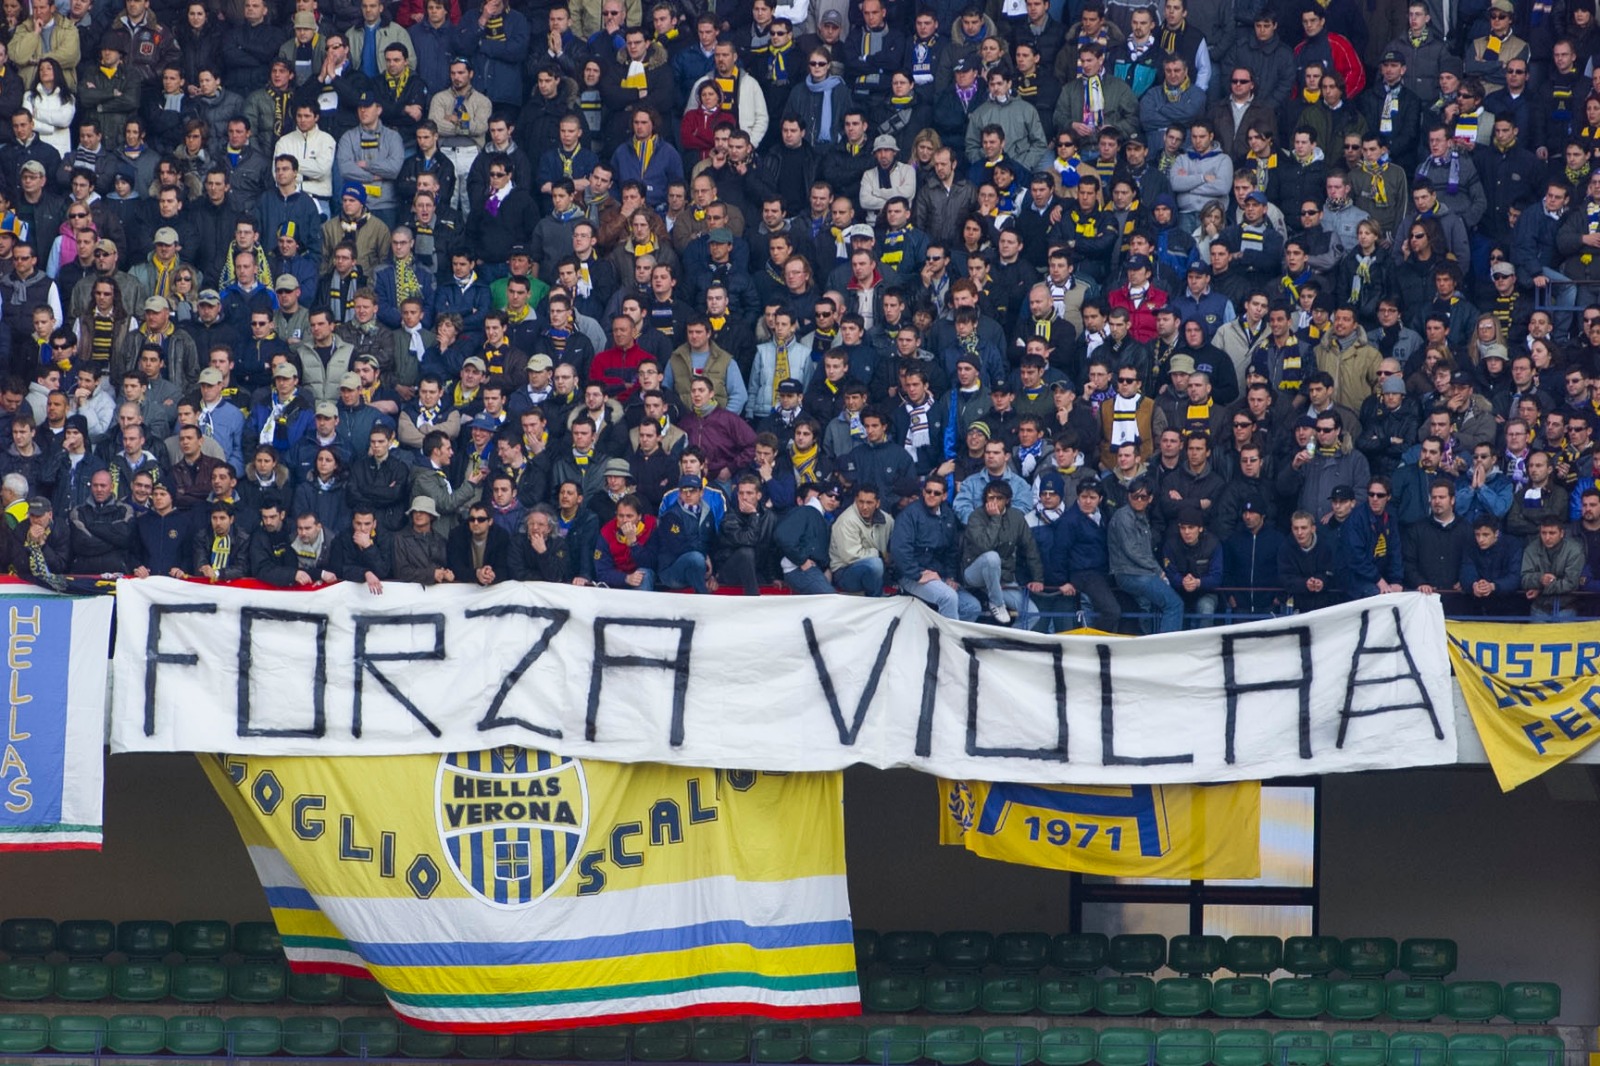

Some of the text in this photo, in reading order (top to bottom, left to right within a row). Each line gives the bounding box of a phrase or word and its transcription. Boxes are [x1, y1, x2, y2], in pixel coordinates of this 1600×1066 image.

[0, 605, 41, 814] HELLAS
[142, 602, 696, 747] FORZA
[444, 800, 578, 828] VERONA
[453, 775, 562, 799] HELLAS
[576, 768, 791, 897] SCAL
[1024, 816, 1122, 852] 1971
